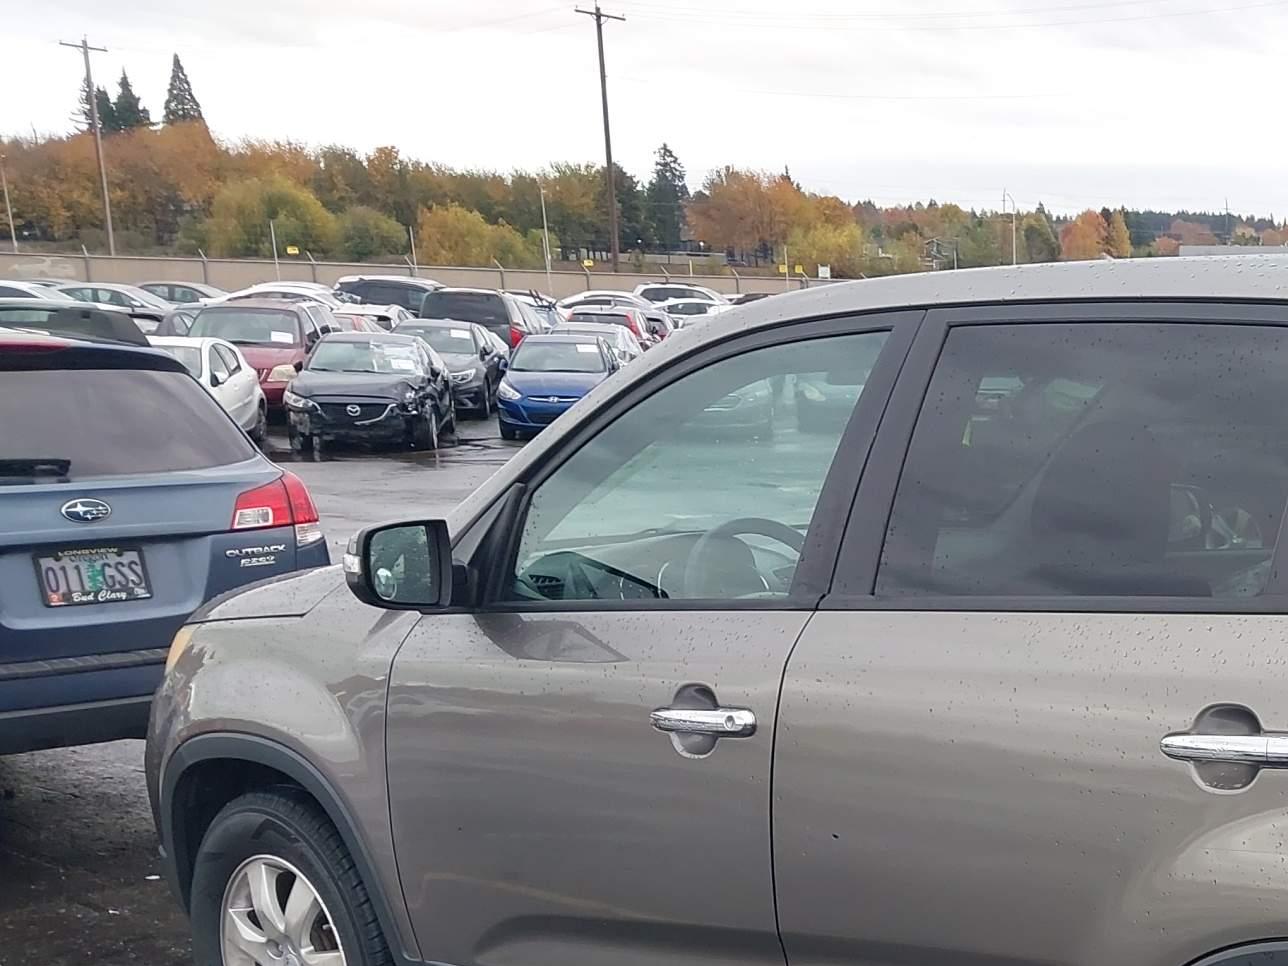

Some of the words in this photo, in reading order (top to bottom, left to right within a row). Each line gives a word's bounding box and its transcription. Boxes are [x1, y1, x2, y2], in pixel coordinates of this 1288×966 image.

[58, 547, 118, 556] LONGVIEW
[225, 544, 286, 557] OUTBACK
[101, 560, 144, 588] GSS
[72, 592, 95, 602] Bud
[98, 589, 127, 602] Clary
